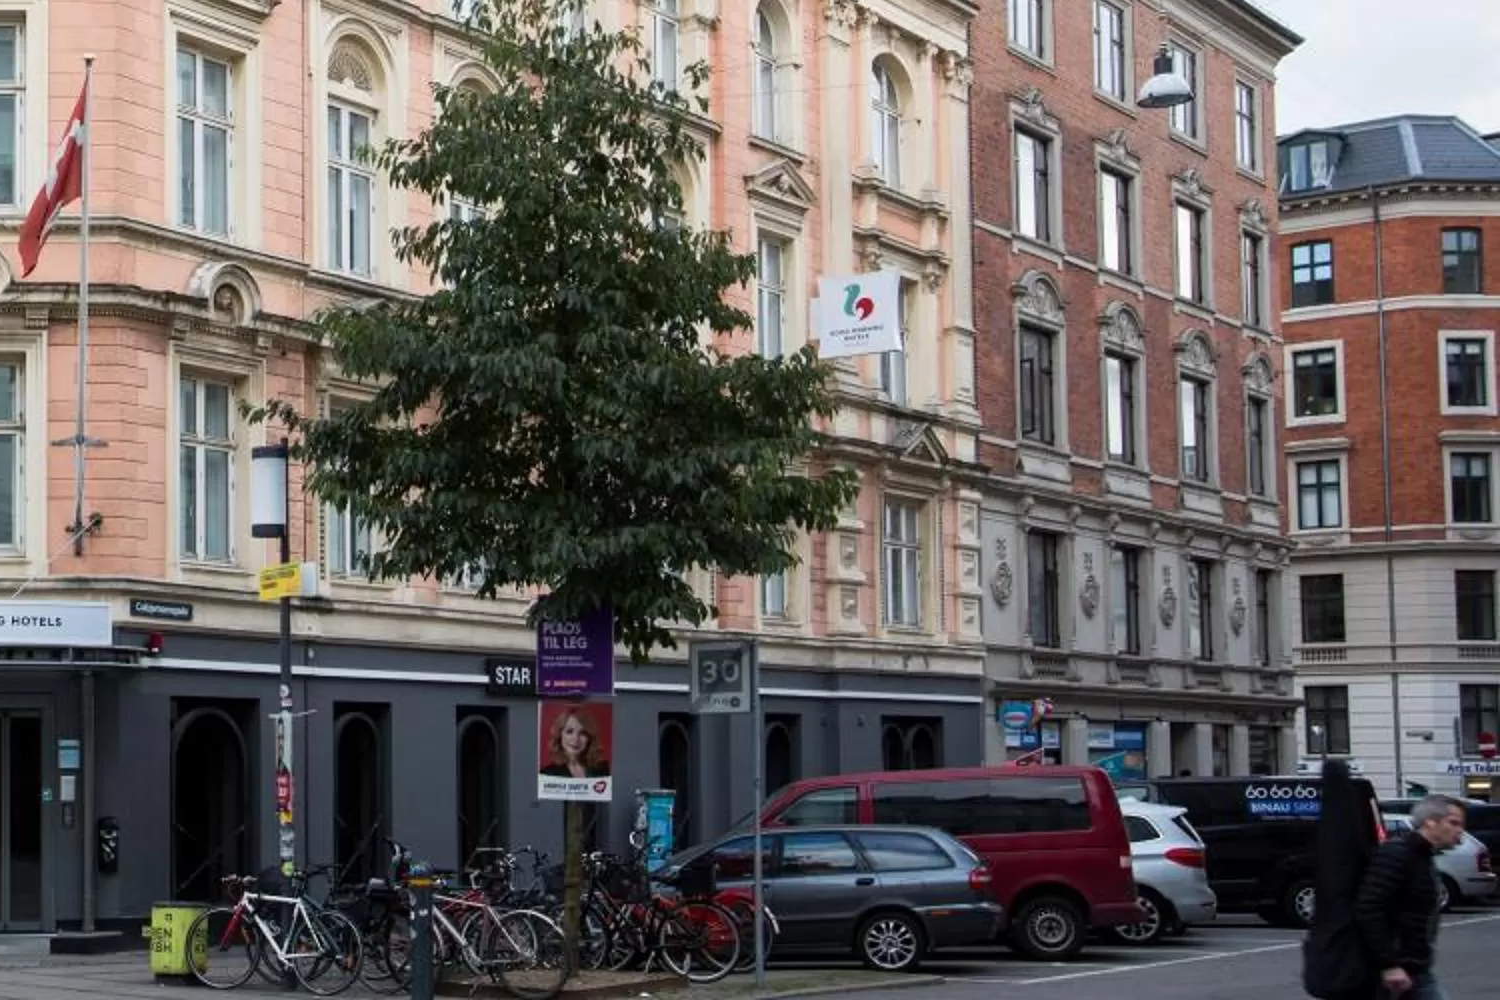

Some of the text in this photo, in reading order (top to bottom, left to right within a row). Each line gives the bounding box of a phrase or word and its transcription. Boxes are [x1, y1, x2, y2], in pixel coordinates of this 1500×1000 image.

[11, 615, 63, 627] HOTELS
[542, 635, 588, 649] TIL LEG
[495, 665, 531, 685] STAR
[702, 660, 740, 684] 30
[1245, 784, 1317, 799] 60 60 60
